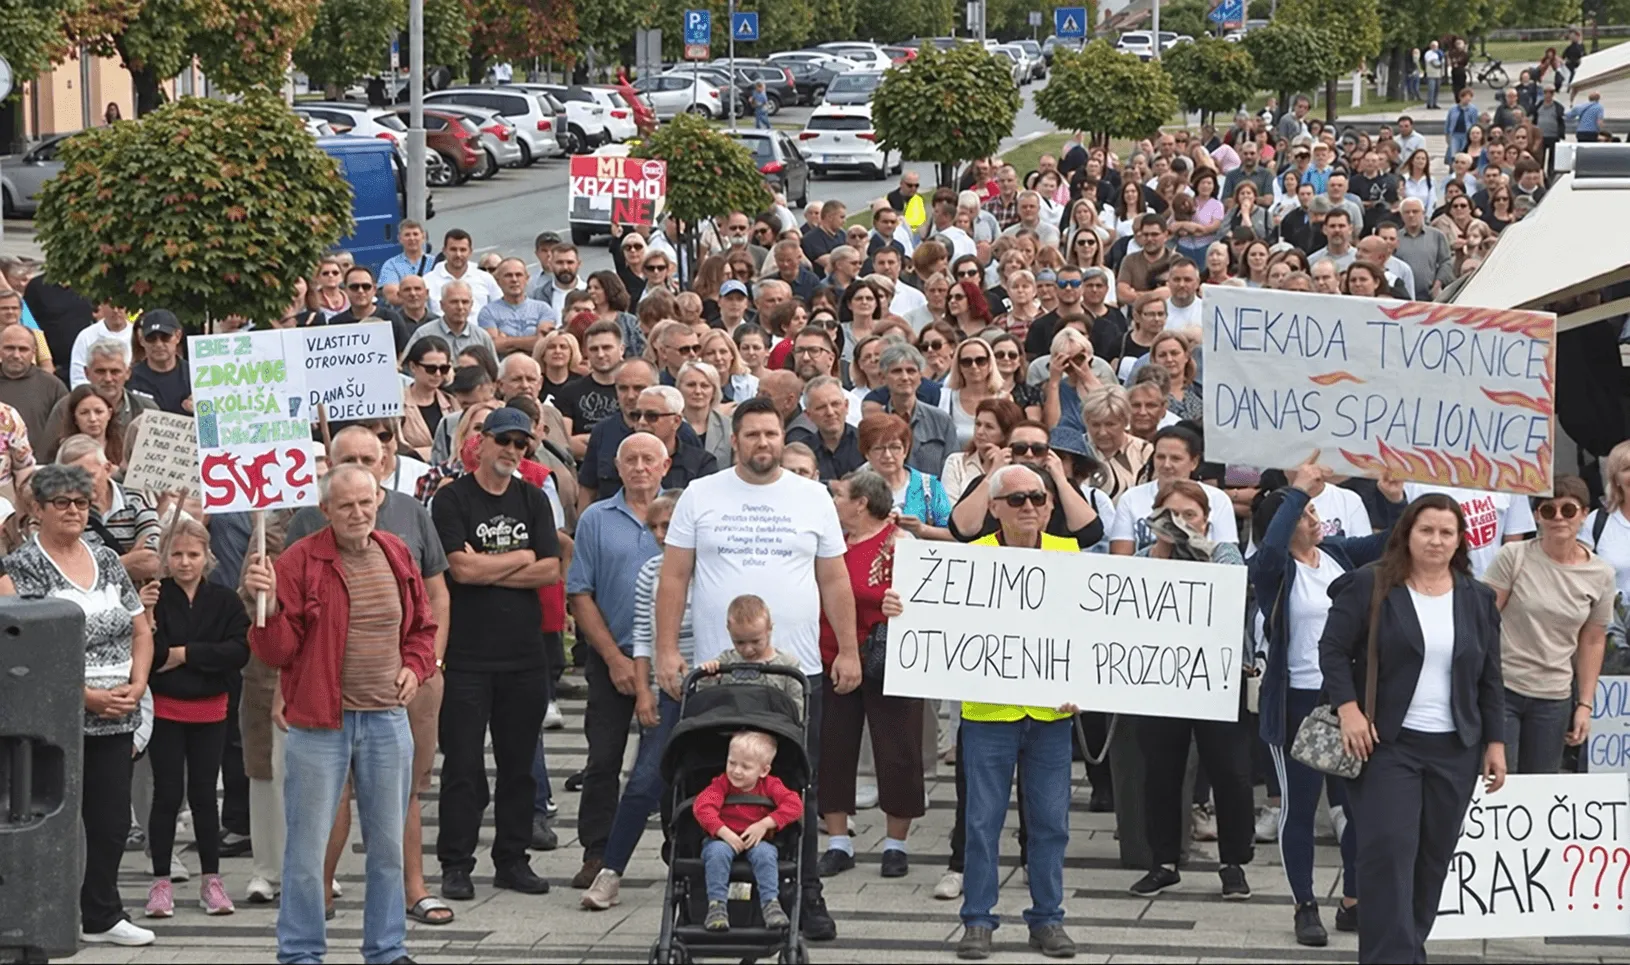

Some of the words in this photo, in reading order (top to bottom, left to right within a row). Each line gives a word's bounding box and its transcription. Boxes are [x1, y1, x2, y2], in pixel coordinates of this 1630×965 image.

[597, 157, 626, 178] MI
[613, 198, 653, 226] NE
[194, 336, 252, 358] BEZ
[306, 334, 371, 352] VLASTITU
[1213, 305, 1347, 361] NEKADA
[1366, 320, 1550, 379] TVORNICE
[193, 359, 288, 388] ZDRAVOG
[310, 377, 366, 406] DANAŠU
[1216, 383, 1321, 432] DANAS
[1331, 394, 1548, 453] SPALIONICE
[910, 549, 1046, 610] ŽELIMO
[1079, 572, 1214, 627] SPAVATI
[899, 630, 1071, 682] OTVORENIH
[1459, 797, 1533, 841] ŠTO
[1548, 794, 1627, 841] ČIST
